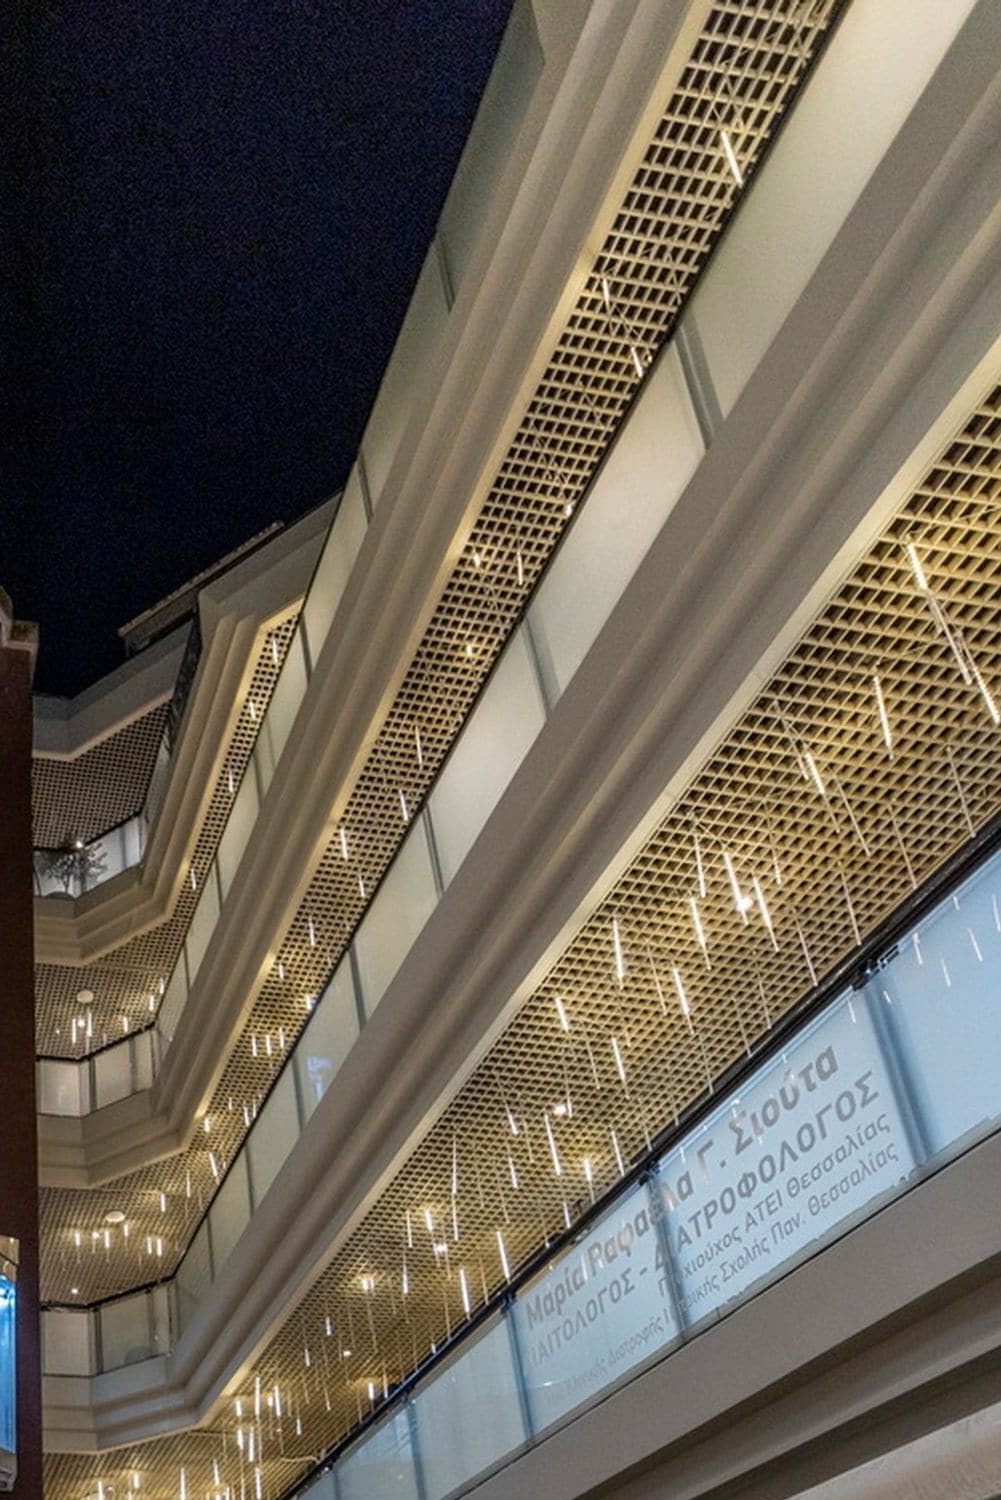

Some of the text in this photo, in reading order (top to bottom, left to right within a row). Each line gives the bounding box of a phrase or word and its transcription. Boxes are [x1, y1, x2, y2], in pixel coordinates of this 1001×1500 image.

[525, 1267, 586, 1331] Μαρία
[728, 1045, 840, 1156] Σιούτα
[655, 1070, 880, 1272] ΔΑΤΡΟΦΟΛΟΓΟΣ
[720, 1235, 771, 1284] Σχολής
[770, 1217, 806, 1245] Παν.
[807, 1142, 899, 1217] Θεσσαλίας
[745, 1189, 783, 1234] ΑΤΕΙ
[787, 1112, 892, 1199] Θεσσαλίας
